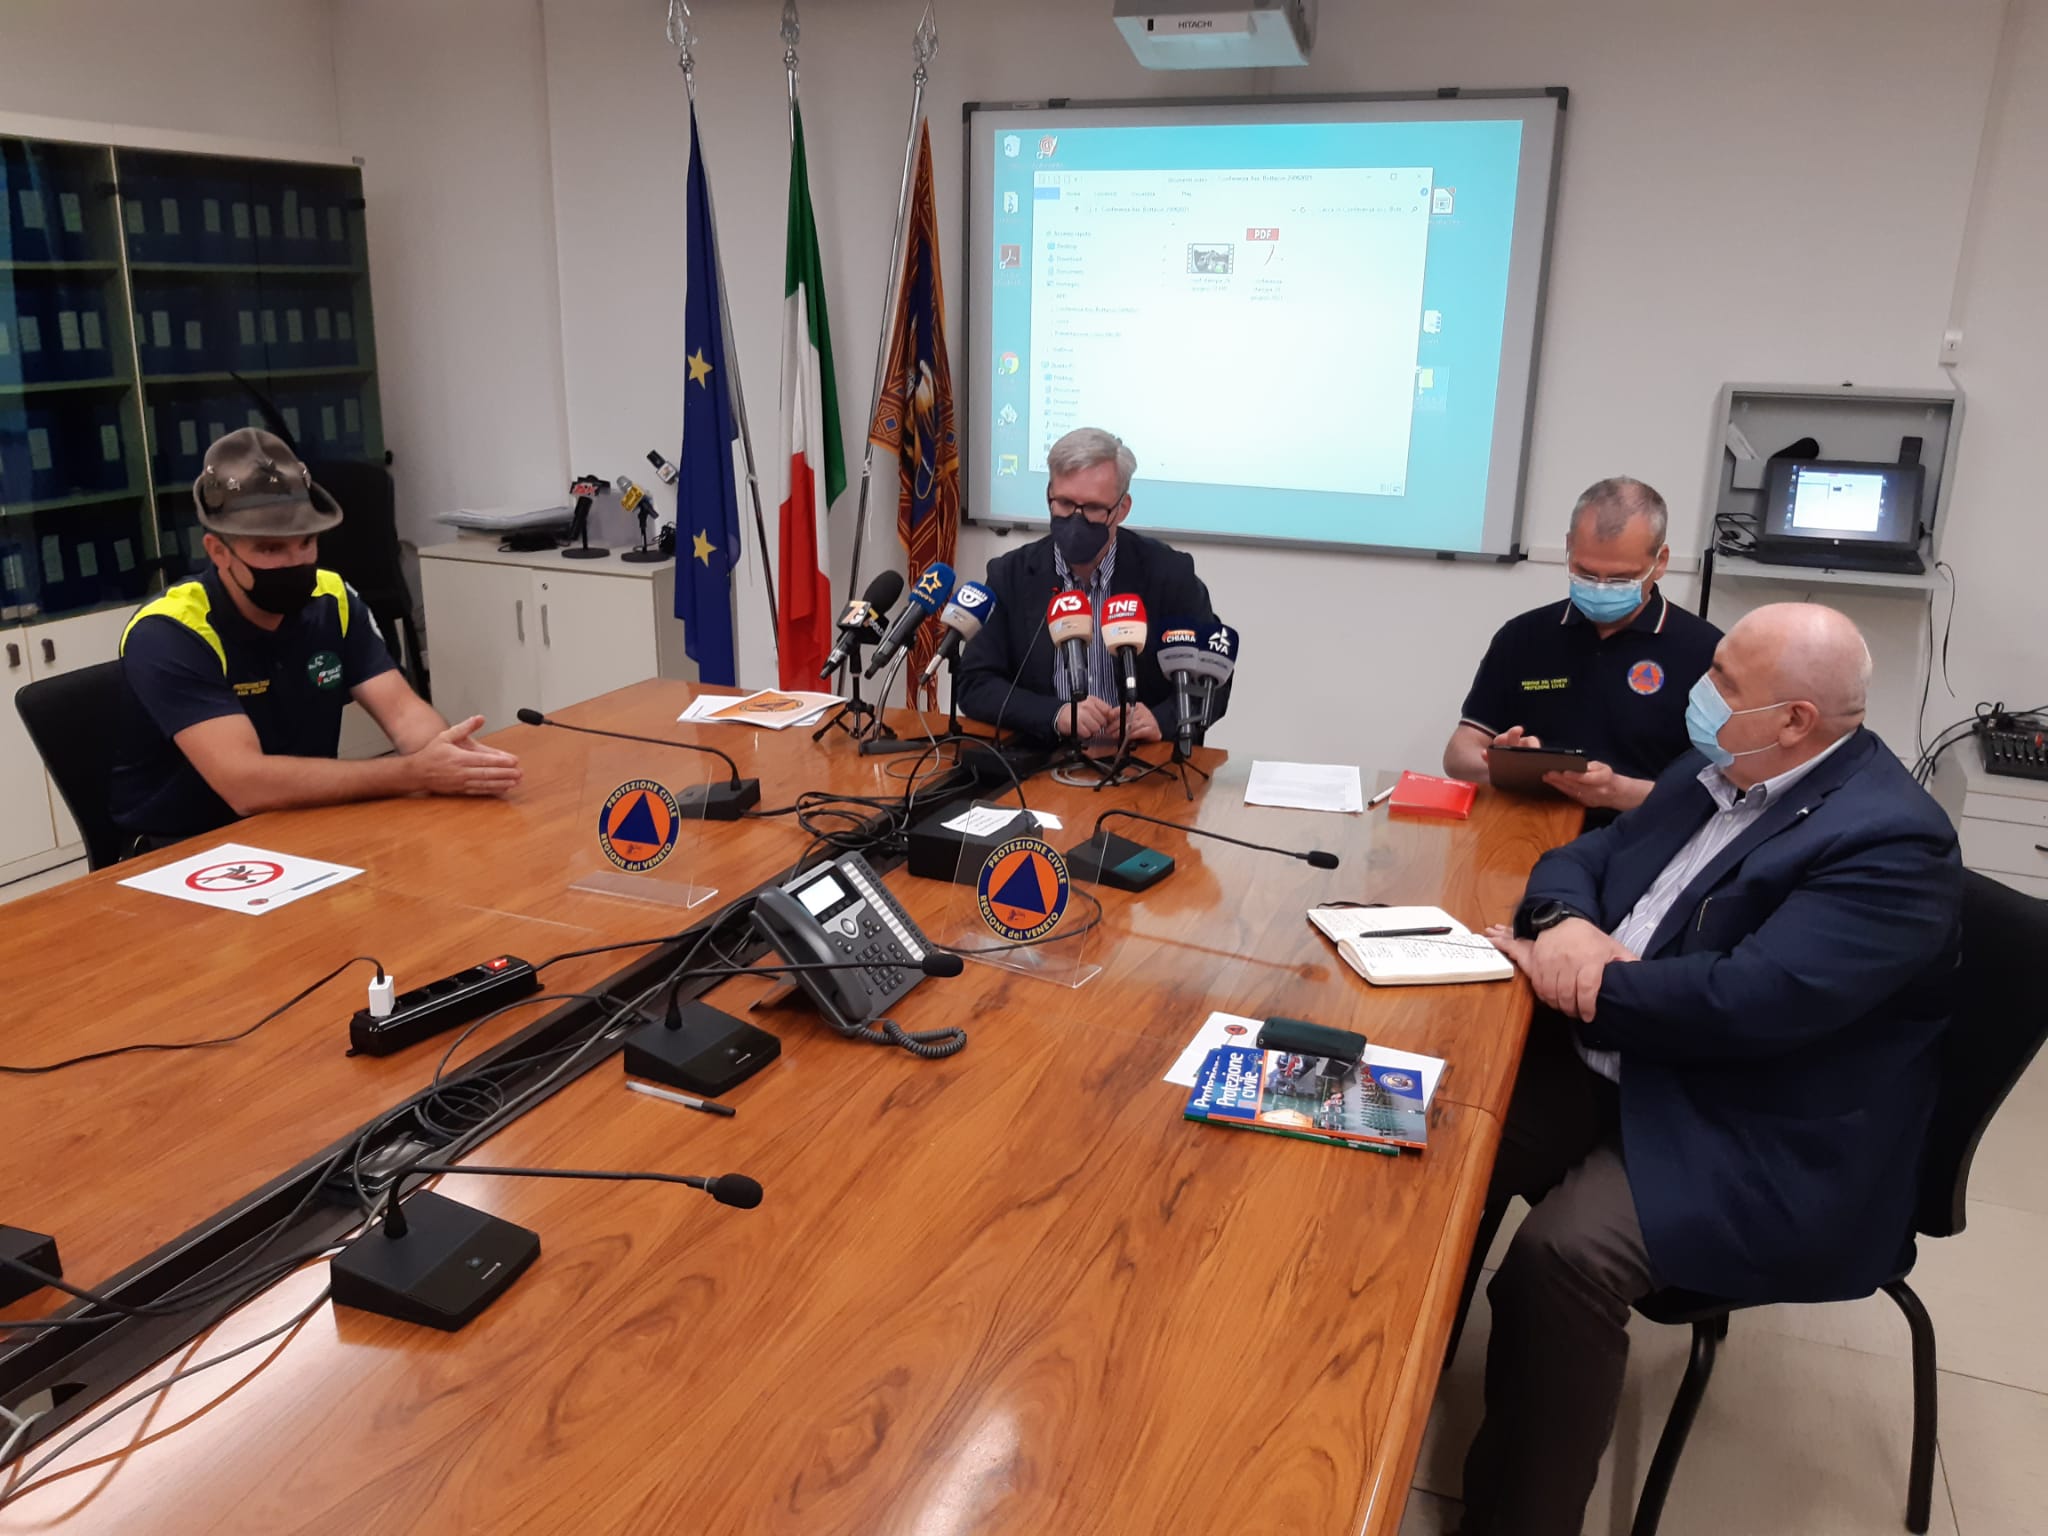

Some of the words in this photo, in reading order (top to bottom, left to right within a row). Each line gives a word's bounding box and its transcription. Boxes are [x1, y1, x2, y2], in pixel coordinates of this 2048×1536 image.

[1178, 20, 1213, 29] HITACHI
[1254, 229, 1272, 240] PDF
[1108, 600, 1138, 614] TNE
[1167, 634, 1196, 643] CHIARA
[1208, 641, 1229, 655] TVA
[607, 781, 659, 809] PROTEZIONE
[659, 789, 677, 818] CIVILE
[601, 833, 626, 867] REGIONE
[627, 861, 641, 870] del
[642, 843, 672, 869] VENETO
[988, 840, 1047, 868] PROTEZIONE
[1047, 852, 1066, 884] CIVILE
[980, 894, 1007, 934] REGIONE
[1008, 930, 1023, 939] del
[1025, 912, 1059, 939] VENETO
[1216, 1052, 1244, 1107] Protezione
[1239, 1071, 1259, 1099] civile
